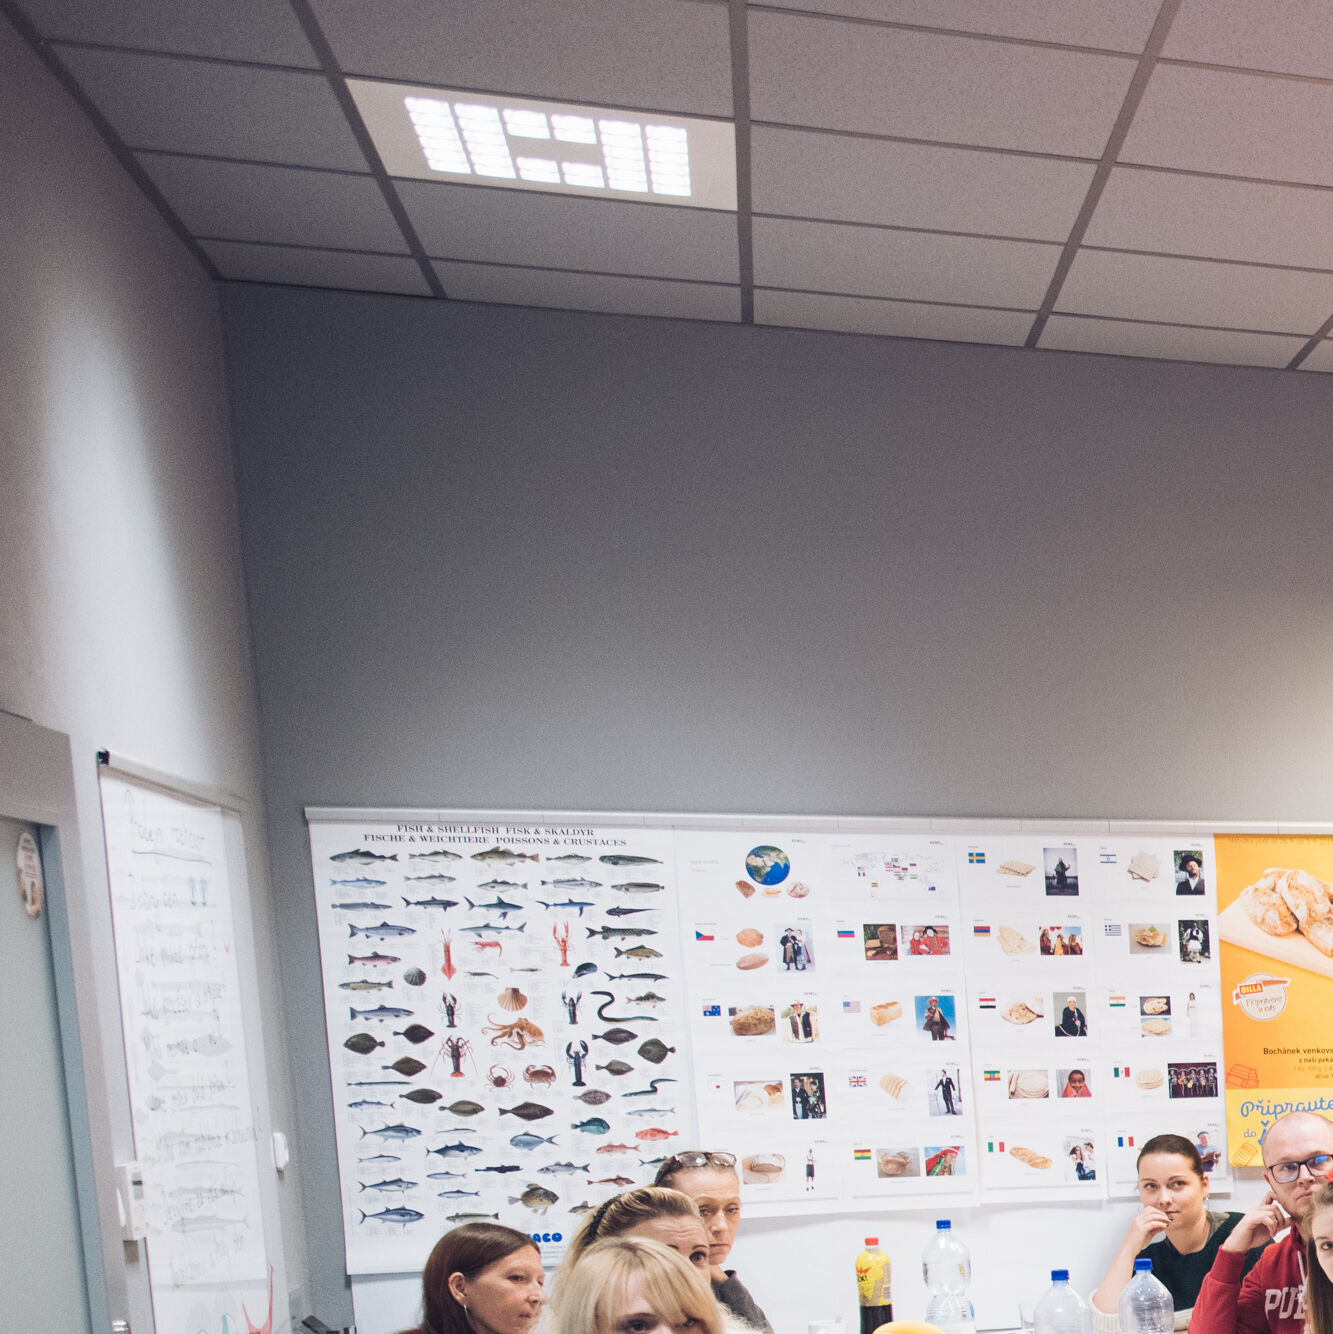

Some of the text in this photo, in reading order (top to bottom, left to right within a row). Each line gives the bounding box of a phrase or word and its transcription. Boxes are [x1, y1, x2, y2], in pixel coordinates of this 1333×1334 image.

[396, 824, 424, 833] FISH
[426, 825, 434, 833] &
[437, 826, 500, 835] SHELLFISH
[505, 827, 531, 835] FISK
[544, 828, 594, 837] SKALDYR
[363, 834, 406, 842] FISCHE
[419, 835, 490, 844] WEICHTIERE
[495, 837, 550, 845] POISSONS
[552, 838, 561, 846] &
[563, 838, 627, 847] CRUSTACES
[1240, 984, 1262, 994] BILLA
[1263, 1047, 1301, 1055] Bochánek
[1243, 1128, 1257, 1138] do
